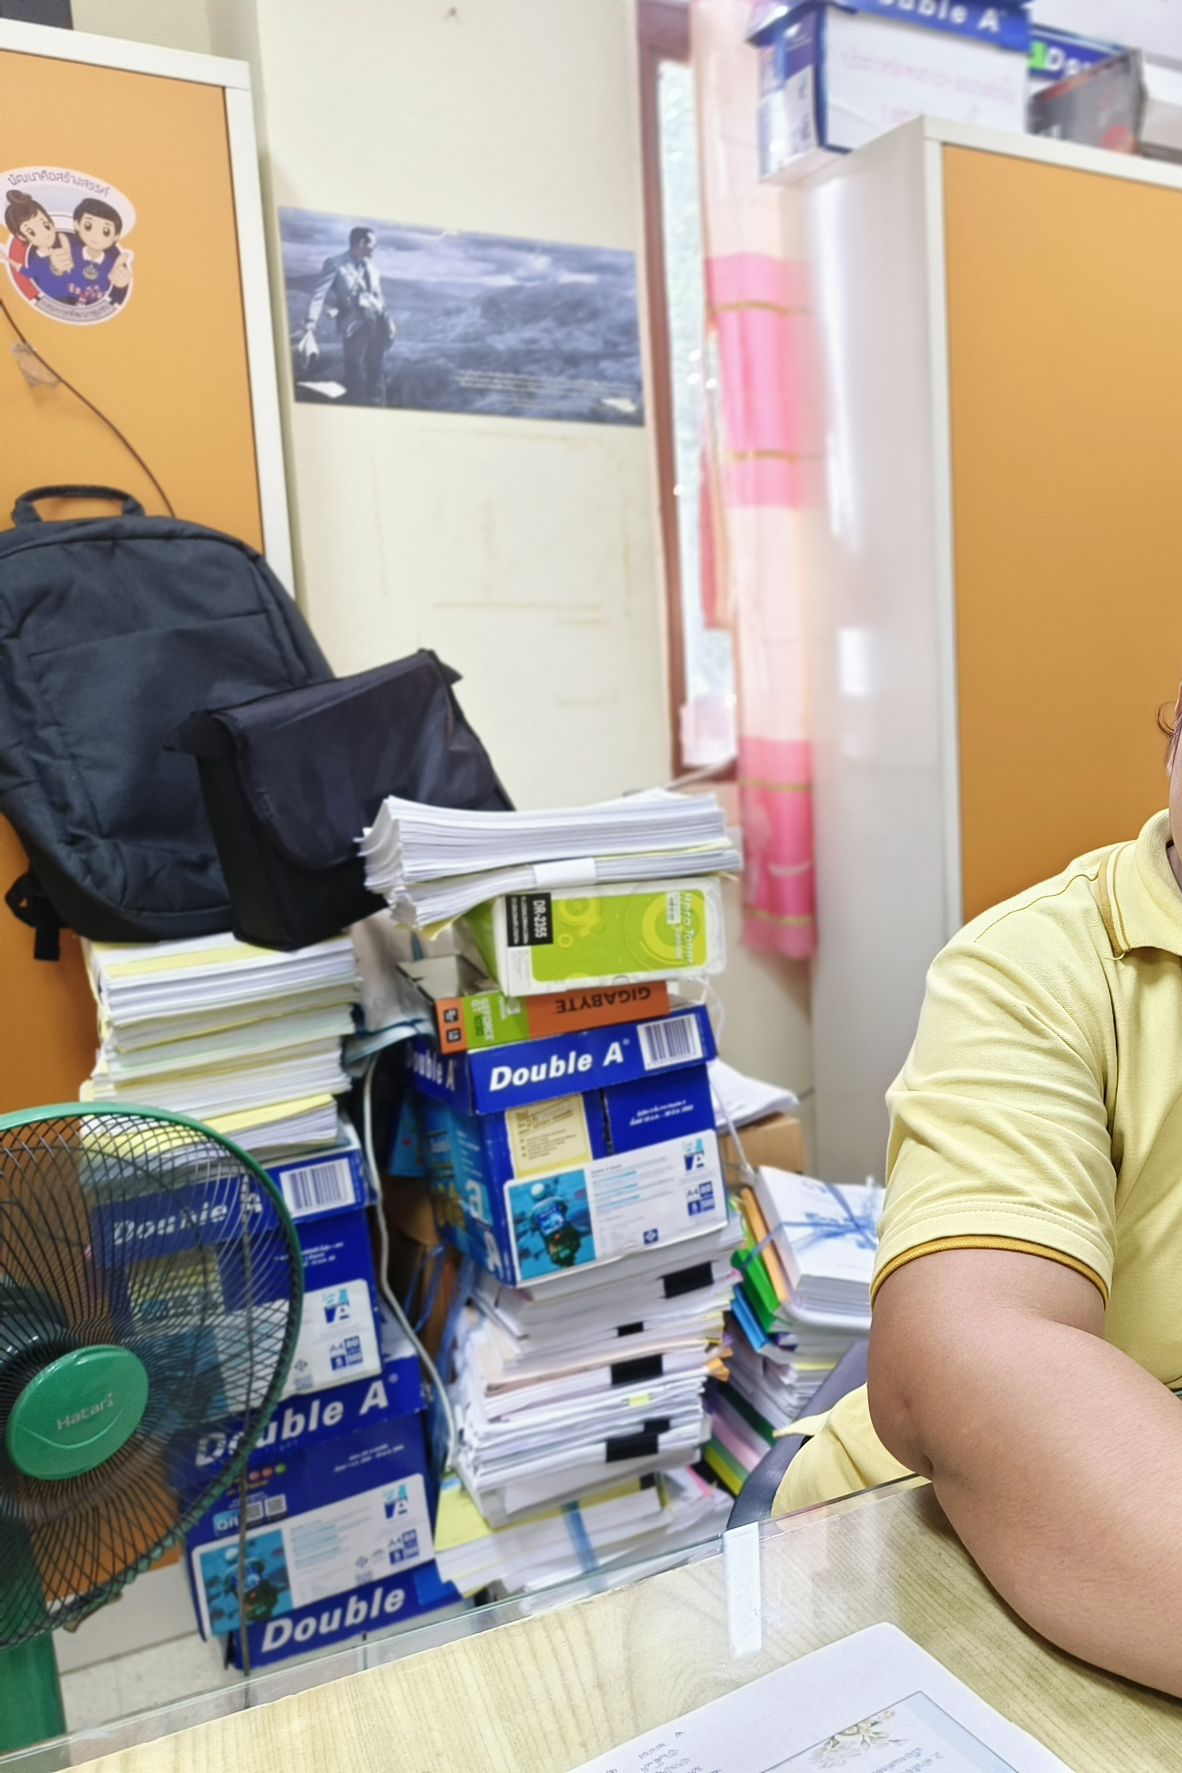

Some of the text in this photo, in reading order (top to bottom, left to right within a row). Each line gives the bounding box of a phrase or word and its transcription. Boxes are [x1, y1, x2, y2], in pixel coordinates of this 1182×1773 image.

[533, 900, 547, 939] DR-2355
[556, 987, 651, 1014] GIGABYTE
[489, 1051, 593, 1091] Double
[56, 1392, 114, 1430] Hatari
[262, 1587, 405, 1652] Double
